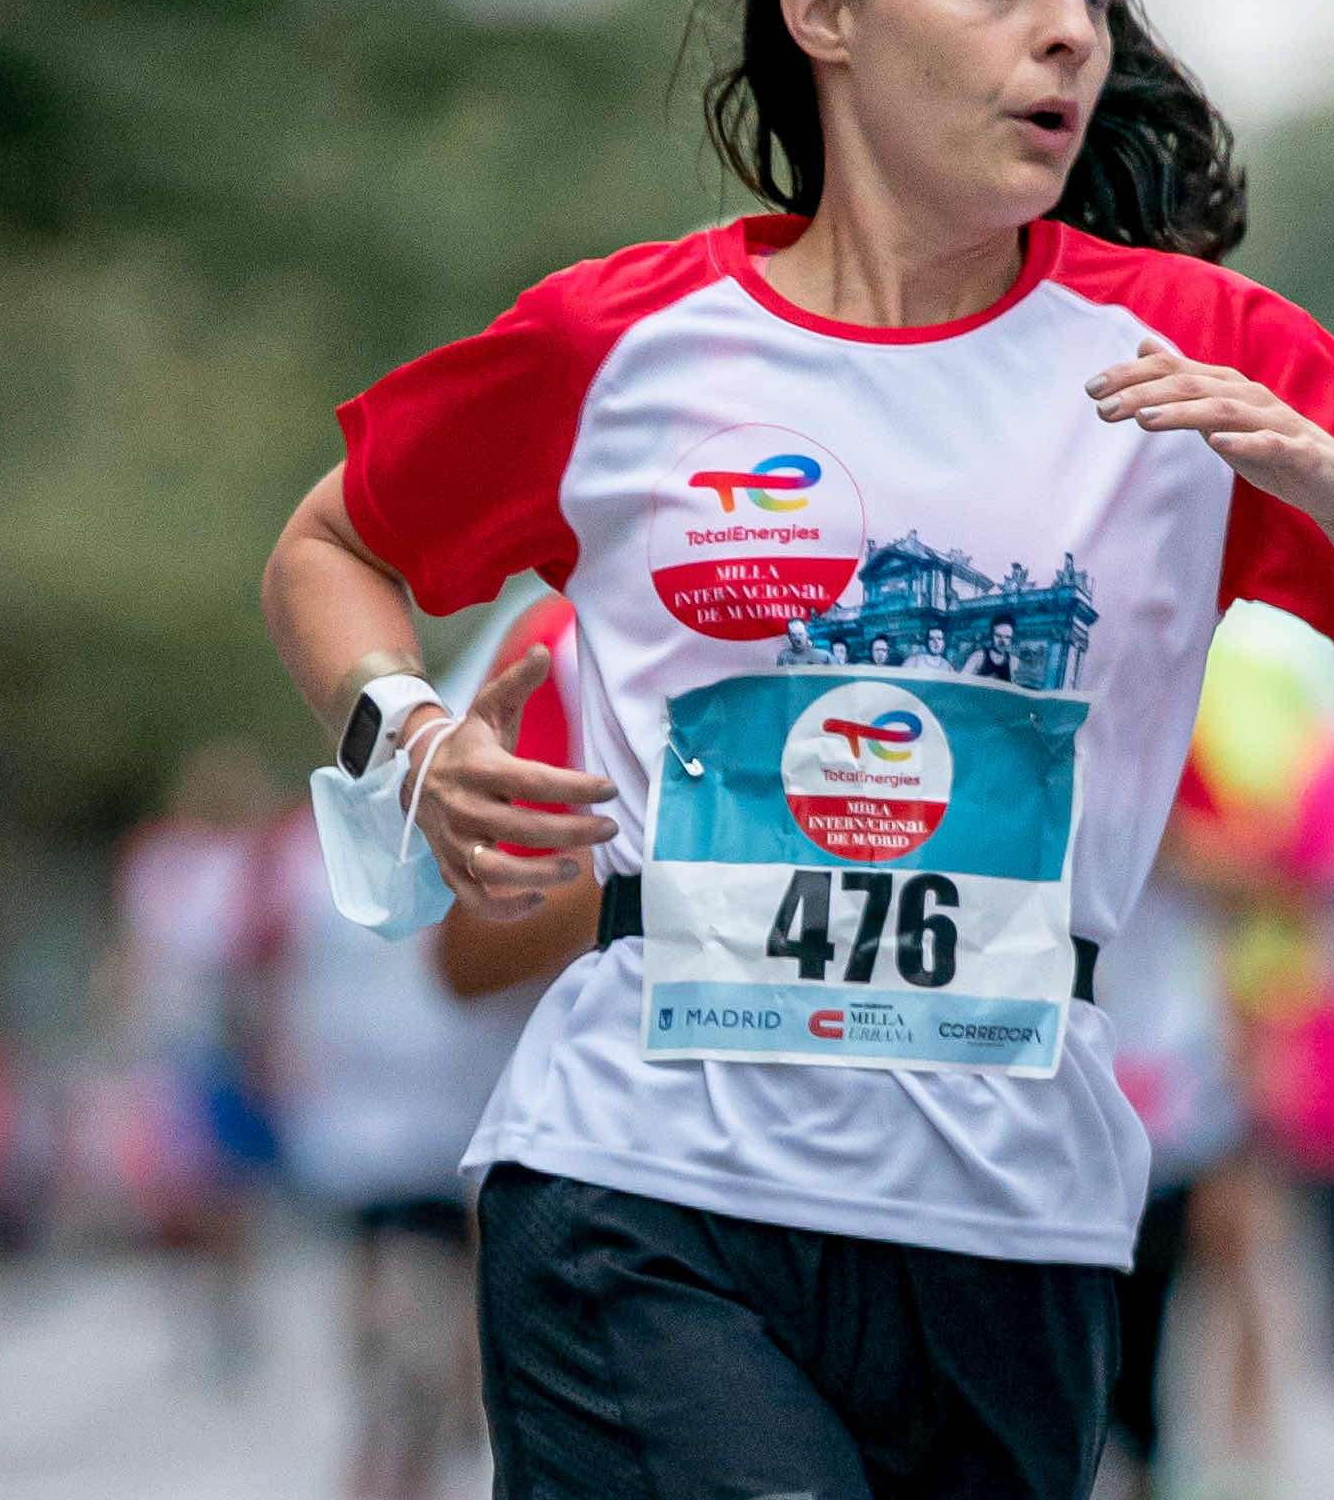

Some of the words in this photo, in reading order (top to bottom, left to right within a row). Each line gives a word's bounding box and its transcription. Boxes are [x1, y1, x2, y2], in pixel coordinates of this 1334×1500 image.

[685, 524, 820, 546] TotalEnergies
[716, 564, 780, 581] MILLA
[696, 607, 723, 624] DE
[726, 603, 807, 620] MADRID
[826, 832, 848, 845] DE
[767, 870, 960, 987] 476
[685, 1008, 781, 1030] MADRID
[849, 1011, 904, 1027] MILLA
